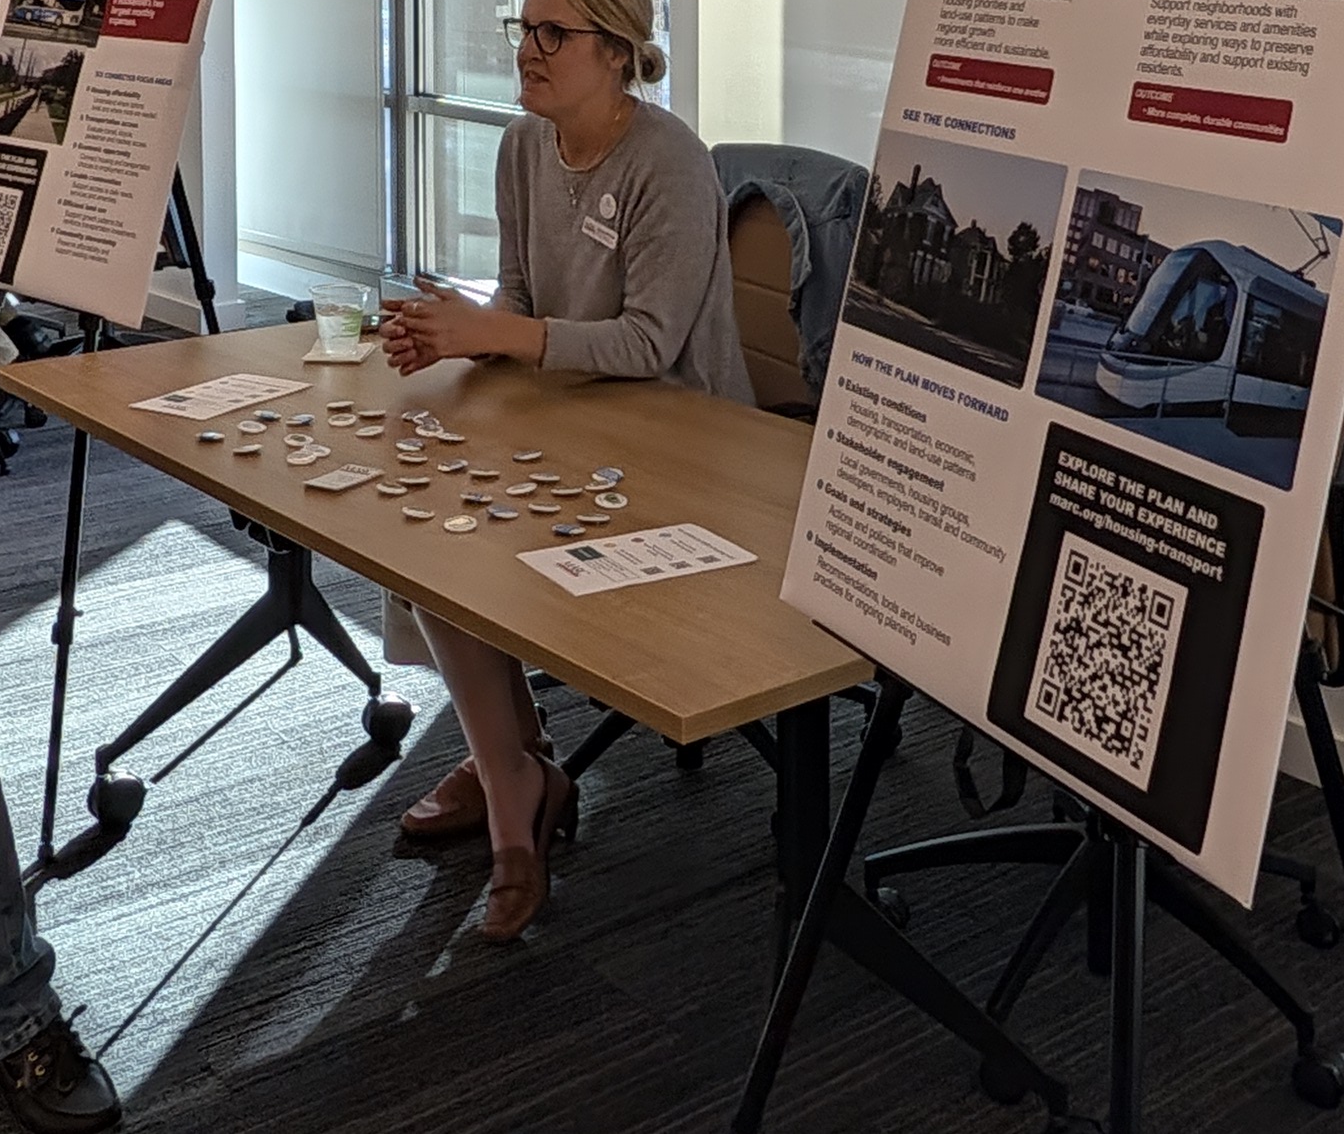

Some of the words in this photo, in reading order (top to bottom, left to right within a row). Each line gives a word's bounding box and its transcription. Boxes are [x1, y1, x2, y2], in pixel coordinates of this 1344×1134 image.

[903, 109, 920, 122] SEE
[923, 112, 941, 126] THE
[943, 117, 1017, 139] CONNECTIONS
[844, 379, 879, 405] Existing
[880, 396, 928, 422] conditions
[850, 349, 872, 369] HOW
[874, 359, 892, 376] THE
[894, 367, 919, 387] PLAN
[920, 377, 955, 401] MOVES
[957, 392, 1009, 422] FORWARD
[835, 431, 884, 464] Stakeholder
[886, 457, 946, 492] engagement
[1058, 450, 1115, 487] EXPLORE
[1117, 475, 1144, 500] THE
[1146, 487, 1184, 516] PLAN
[1185, 504, 1218, 531] AND
[824, 482, 847, 503] Goals
[849, 497, 865, 513] and
[866, 507, 913, 538] strategies
[1049, 494, 1224, 579] marc.org/housing-transport
[1054, 470, 1095, 501] SHARE
[1098, 489, 1135, 518] YOUR
[1136, 506, 1226, 558] EXPERIENCE
[813, 534, 878, 581] Implementation
